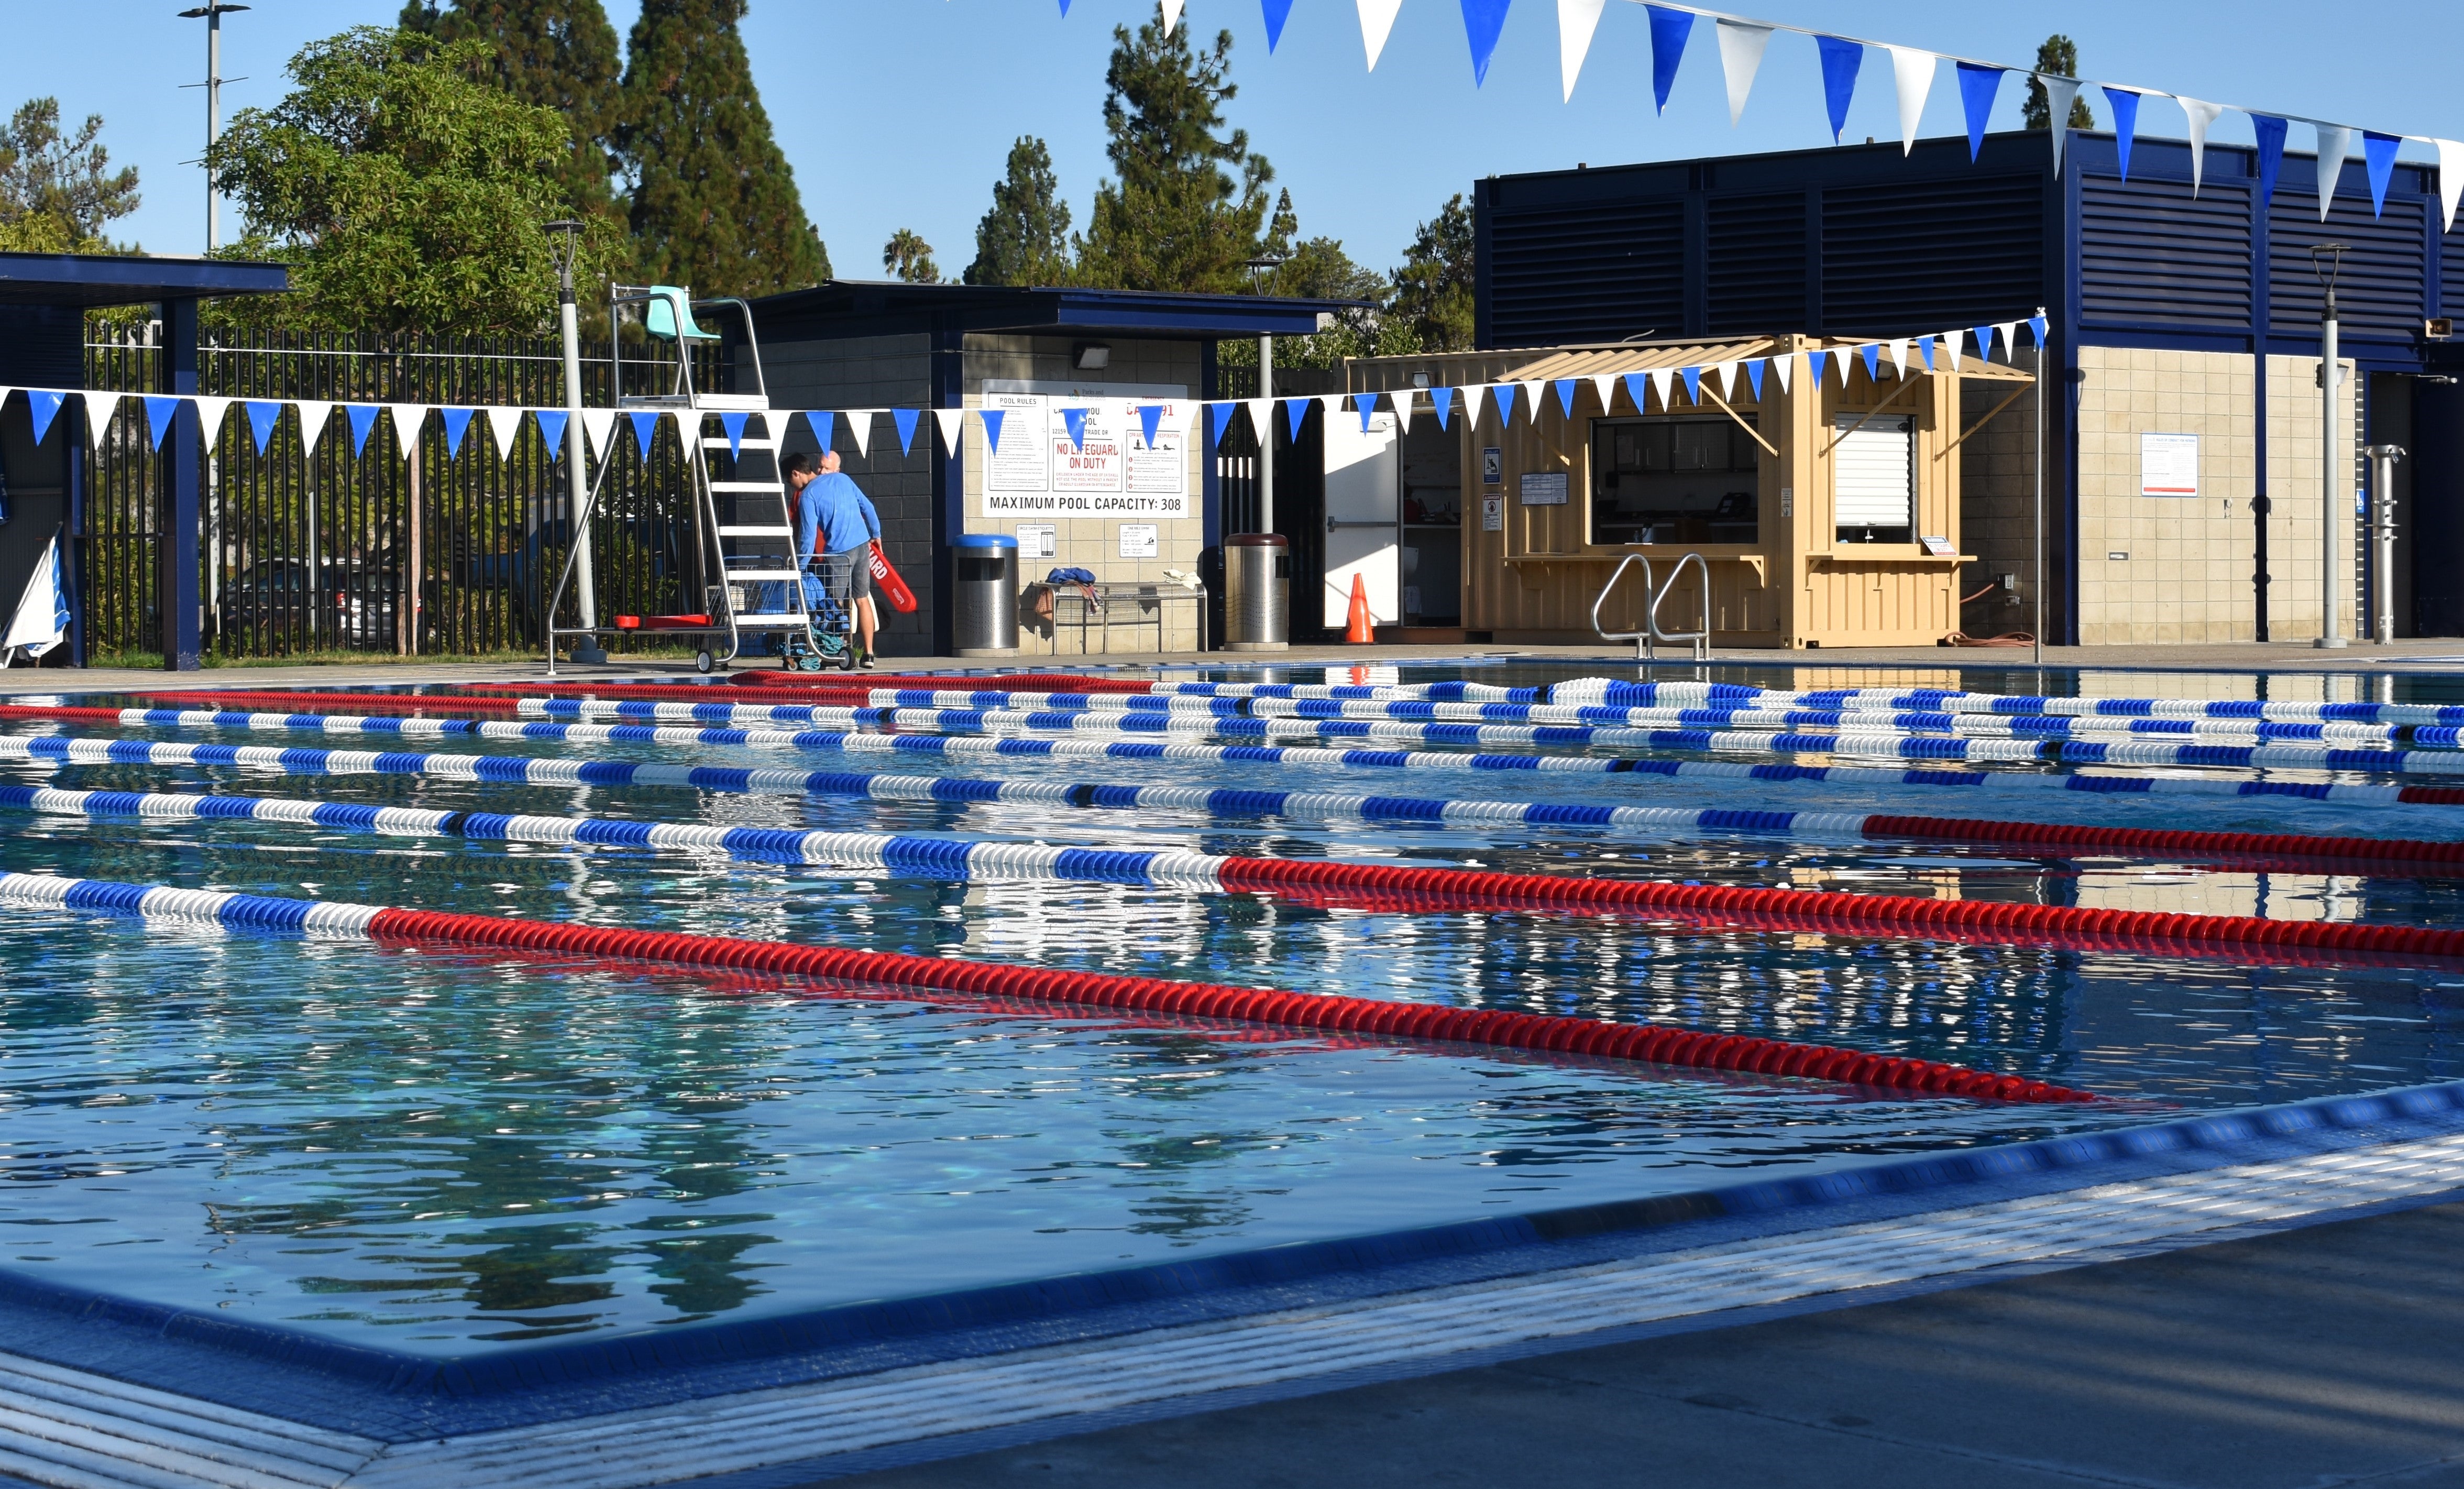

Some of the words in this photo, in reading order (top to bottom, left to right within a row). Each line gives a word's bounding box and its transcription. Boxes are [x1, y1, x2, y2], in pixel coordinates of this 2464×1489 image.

[1057, 443, 1068, 455] NO
[1070, 457, 1080, 468] ON
[1084, 457, 1106, 469] DUTY
[990, 497, 1054, 509] MAXIMUM
[1059, 497, 1090, 509] POOL
[1095, 498, 1158, 510] CAPACITY:
[1161, 498, 1181, 510] 308
